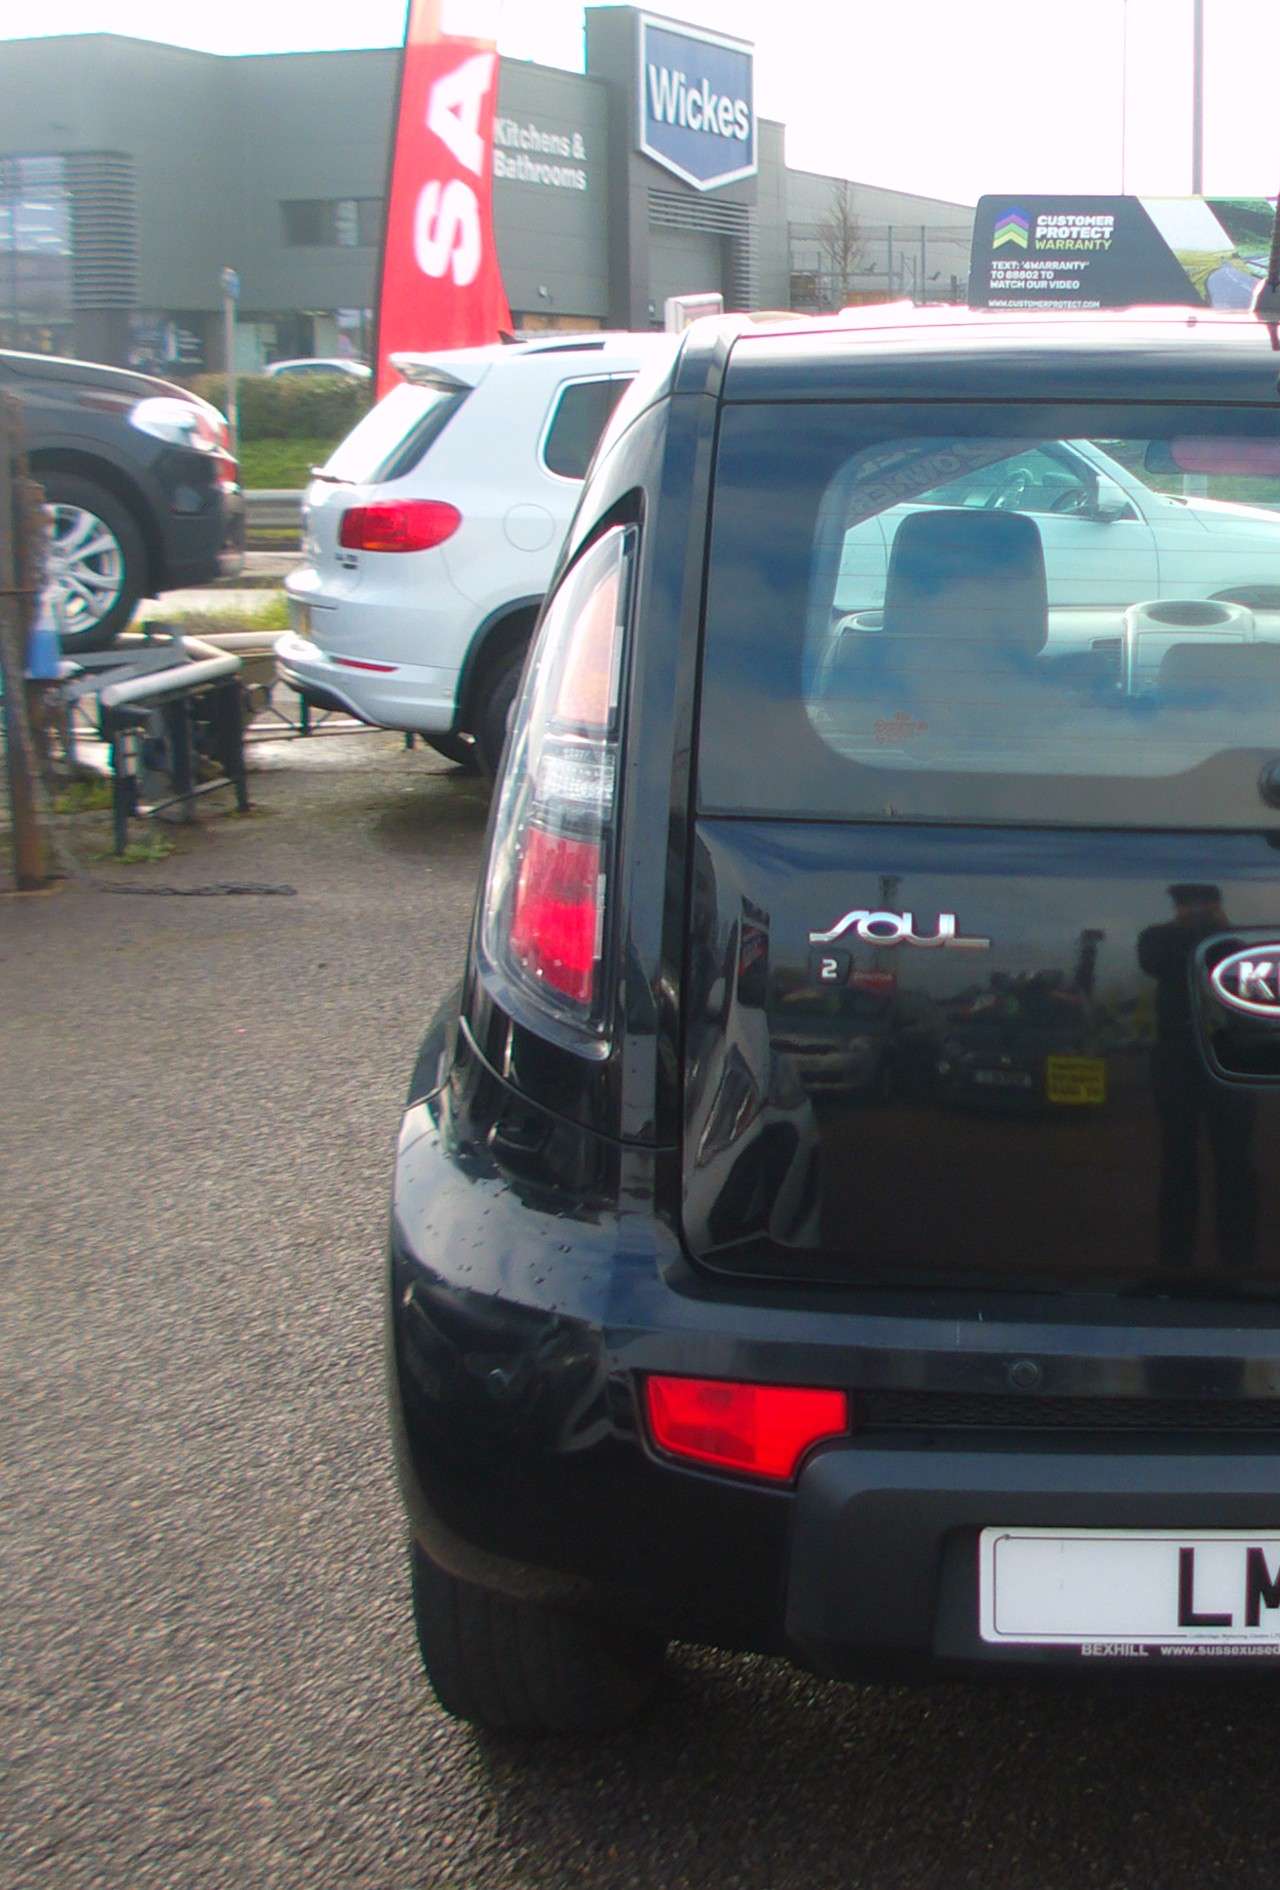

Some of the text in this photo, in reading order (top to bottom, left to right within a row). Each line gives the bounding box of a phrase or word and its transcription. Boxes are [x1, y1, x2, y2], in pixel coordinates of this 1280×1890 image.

[648, 63, 750, 142] Wickes
[494, 117, 588, 161] Kitchens &
[493, 149, 588, 192] Bathrooms
[1037, 215, 1115, 226] CUSTOMER
[1035, 226, 1115, 239] PROTECT
[1035, 239, 1113, 251] WARRANTY
[992, 260, 1020, 270] TEXT:
[991, 270, 1005, 279] TO
[1040, 271, 1054, 280] TO
[990, 280, 1080, 290] WATCH OUR VIDEO
[988, 299, 1100, 309] WWW.CUSTOMERPROTECT.COM
[821, 958, 838, 979] 2
[1080, 1642, 1149, 1657] BEXHILL
